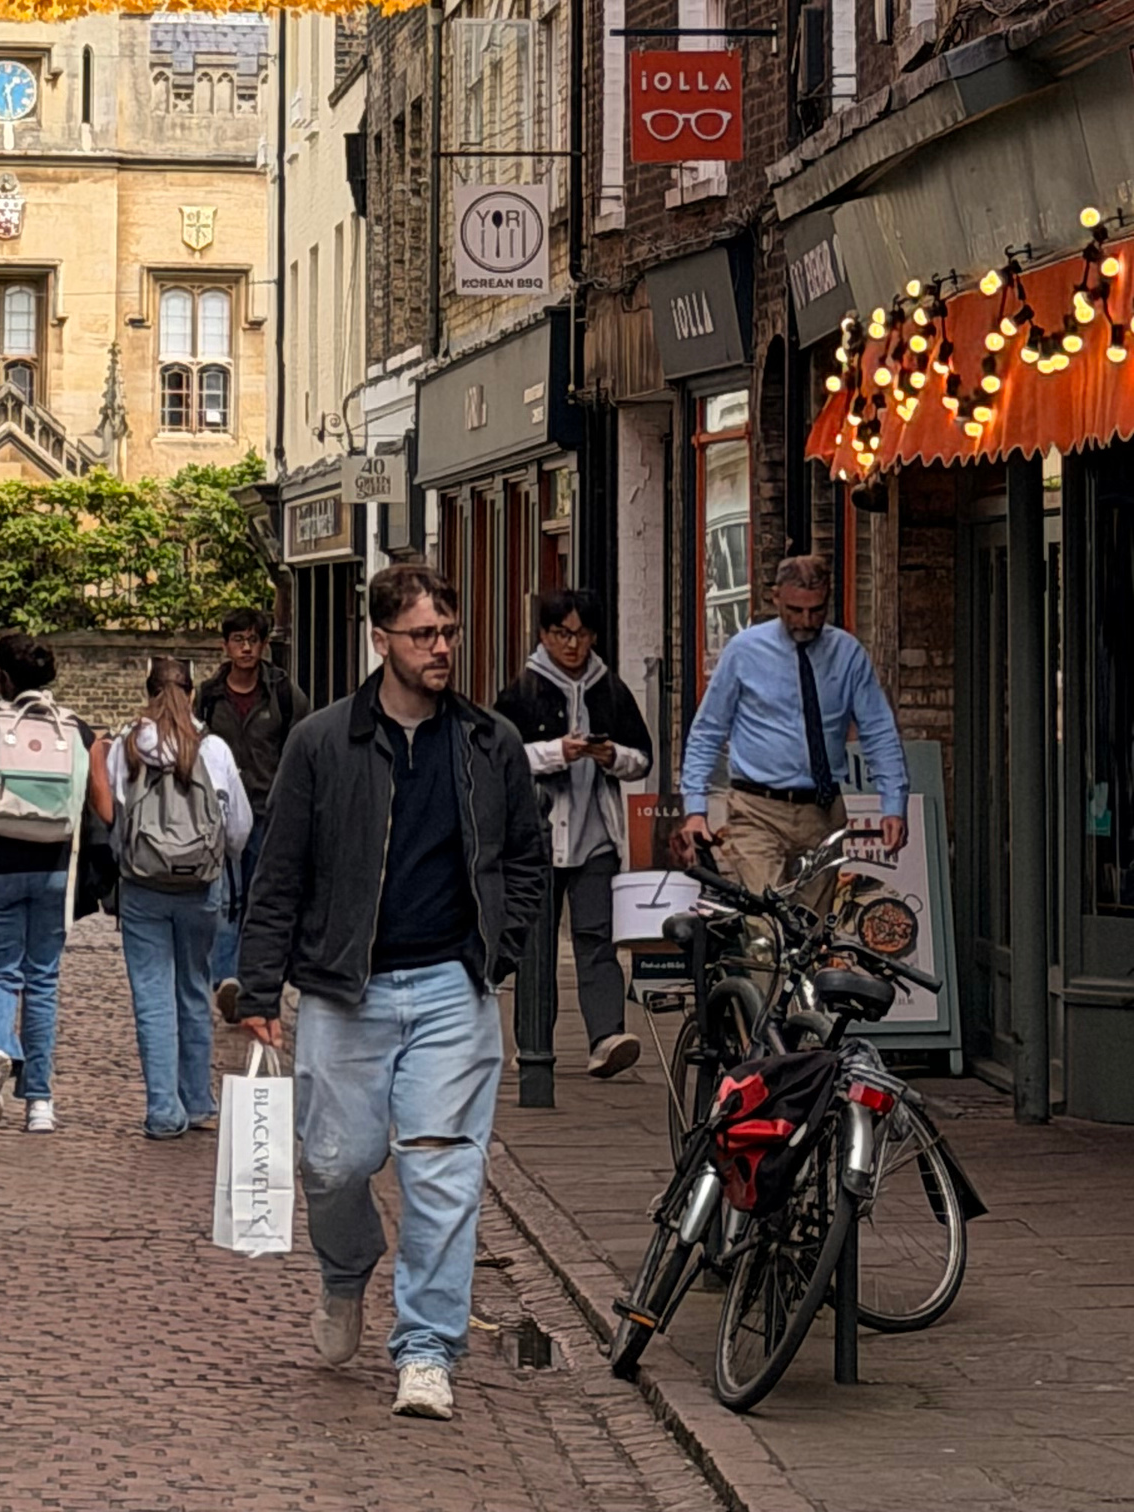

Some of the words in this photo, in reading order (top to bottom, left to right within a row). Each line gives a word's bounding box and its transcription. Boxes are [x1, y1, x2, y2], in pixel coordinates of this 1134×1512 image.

[461, 277, 514, 289] KOREAN
[517, 277, 544, 289] BBQ
[360, 458, 385, 475] 40
